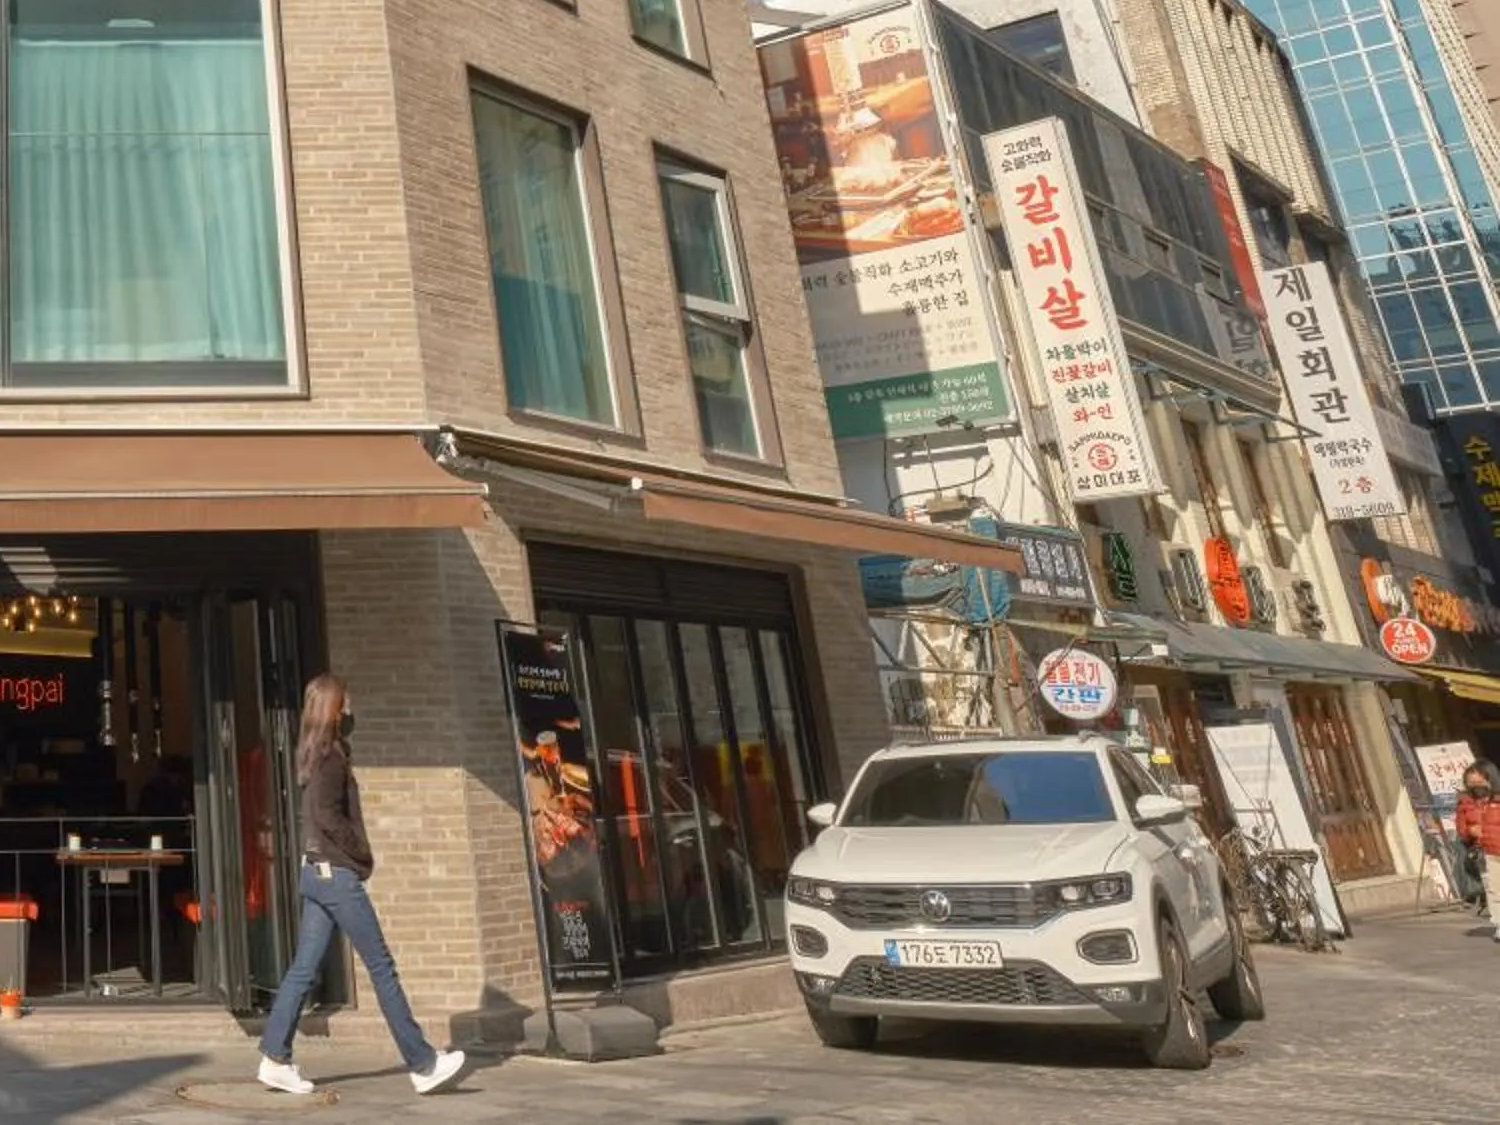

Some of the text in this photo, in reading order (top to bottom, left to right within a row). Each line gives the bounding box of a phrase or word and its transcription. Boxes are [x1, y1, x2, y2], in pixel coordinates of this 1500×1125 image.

[1003, 135, 1043, 156] 고화력
[1015, 174, 1089, 331] 갈비살
[1045, 338, 1108, 361] 차돌박이
[1271, 266, 1352, 424] 제일회관
[1065, 381, 1111, 404] 살치살
[1073, 402, 1115, 423] 와-인
[1076, 468, 1142, 490] 삼미대포
[1392, 622, 1417, 636] 24
[1391, 641, 1429, 655] OPEN
[1052, 686, 1104, 704] 간판
